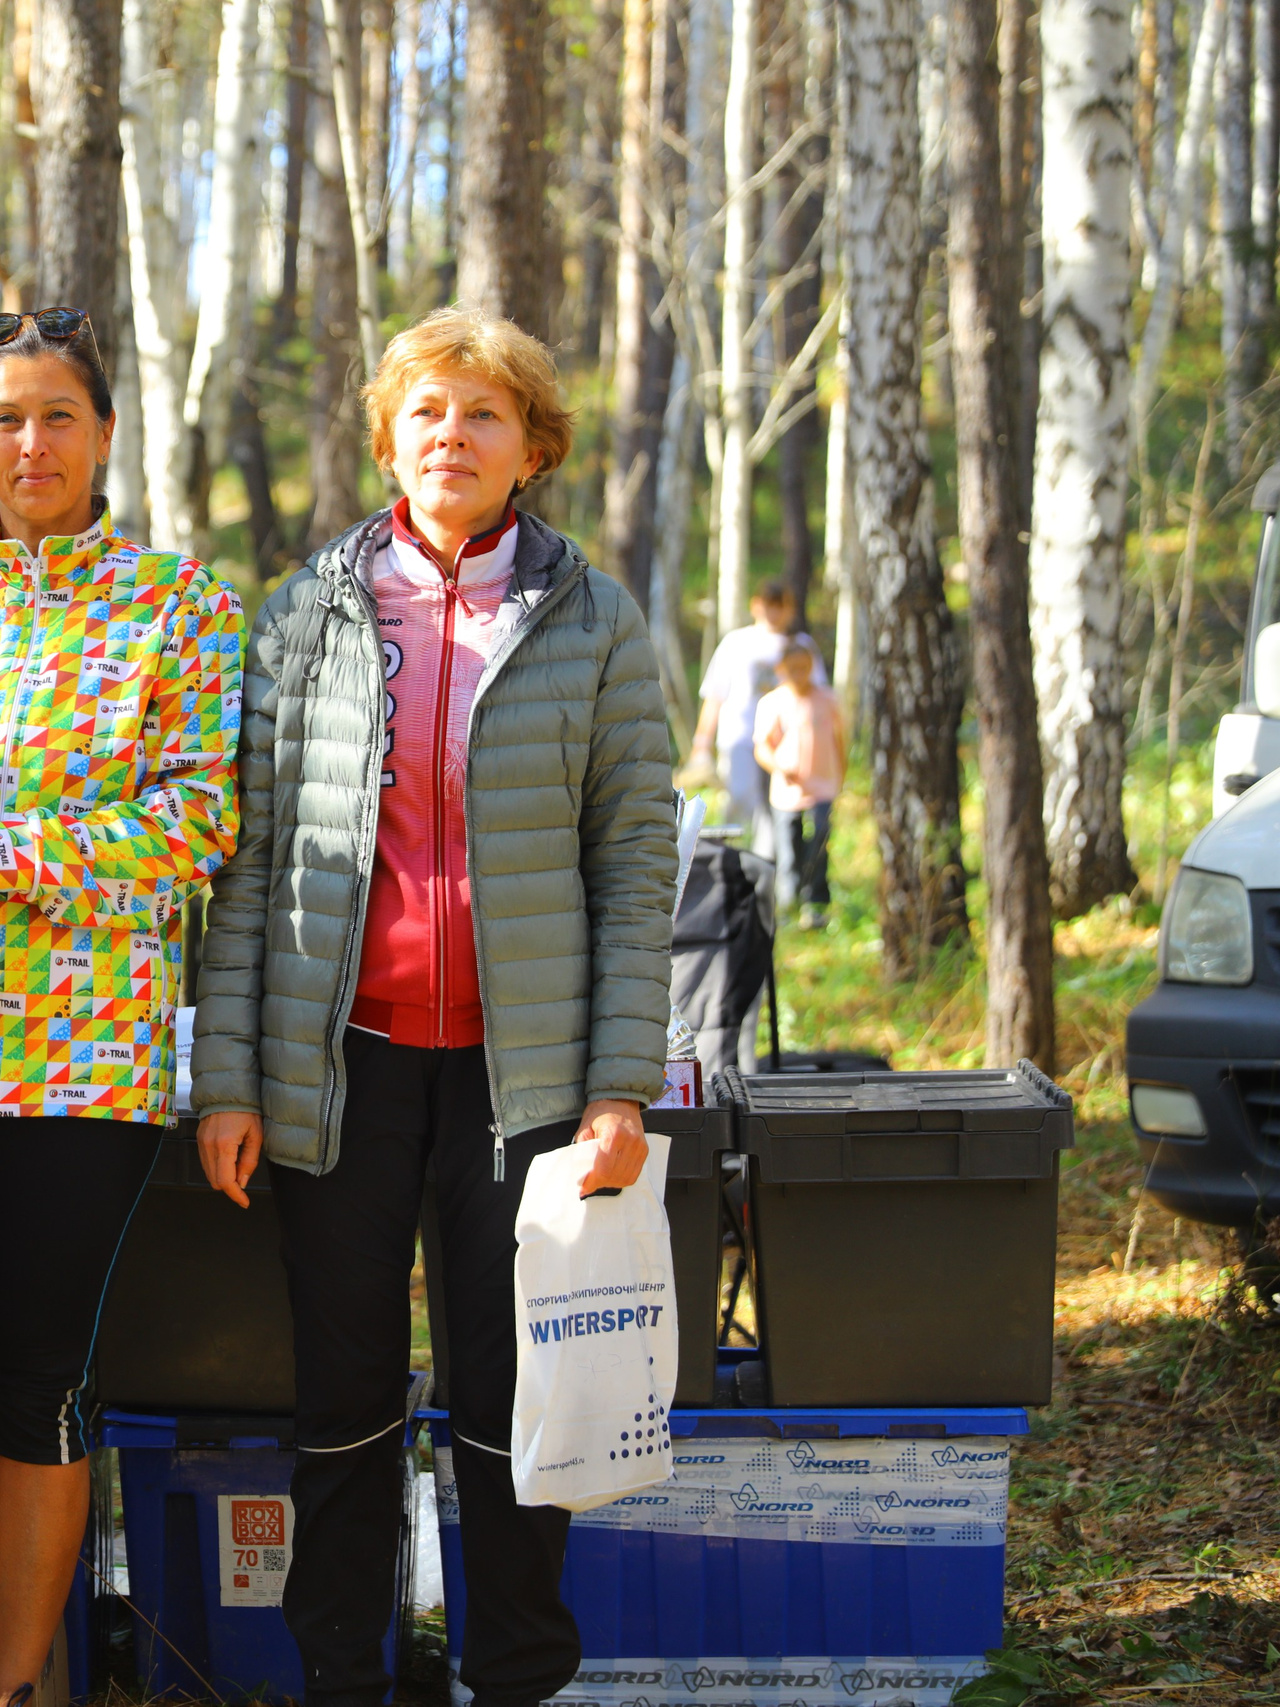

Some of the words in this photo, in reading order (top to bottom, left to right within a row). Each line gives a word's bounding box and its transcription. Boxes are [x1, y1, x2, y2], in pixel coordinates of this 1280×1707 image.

[679, 1083, 690, 1106] 1
[526, 1293, 570, 1308] СПОРТИВ
[570, 1283, 637, 1299] ЭКИПИРОВОЧН
[639, 1282, 666, 1292] ЦЕНТР
[748, 1502, 814, 1512] NORD
[903, 1499, 971, 1508] NORD
[237, 1507, 279, 1522] ROX
[237, 1523, 279, 1538] BOX
[870, 1525, 936, 1536] NORD
[233, 1549, 259, 1567] 70
[718, 1673, 821, 1687] NORD
